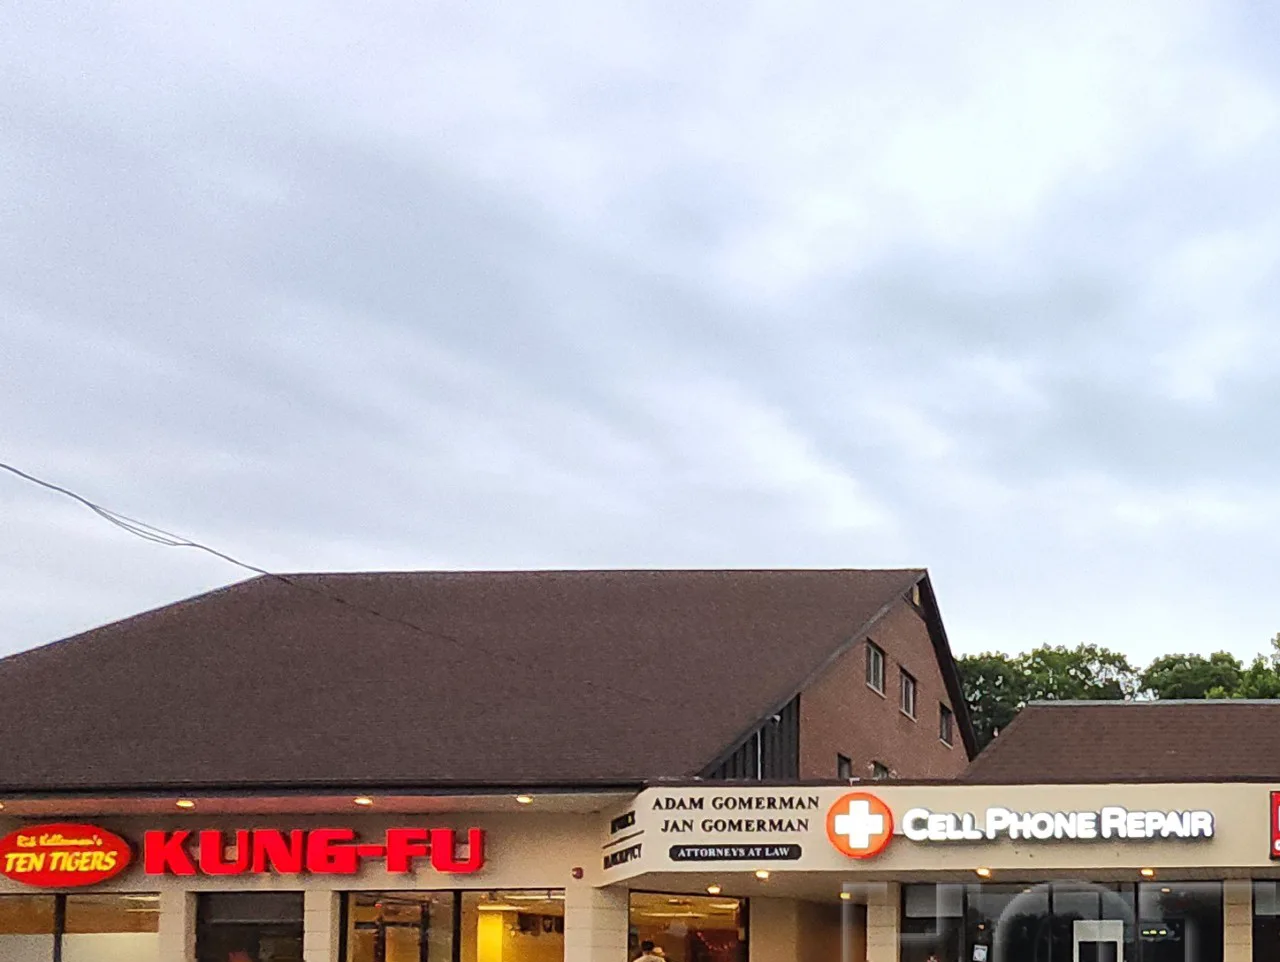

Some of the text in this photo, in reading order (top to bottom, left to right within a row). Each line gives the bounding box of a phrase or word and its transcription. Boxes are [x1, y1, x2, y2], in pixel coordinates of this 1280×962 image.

[652, 796, 819, 810] ADAM GOMERMAN
[660, 818, 809, 833] JAN GOMERMAN
[902, 806, 1214, 841] CELL PHONE REPAIR
[144, 828, 484, 875] KUNG-FU
[677, 847, 790, 859] ATTORNEYS AT LAW
[5, 851, 118, 872] TEN TIGERS
